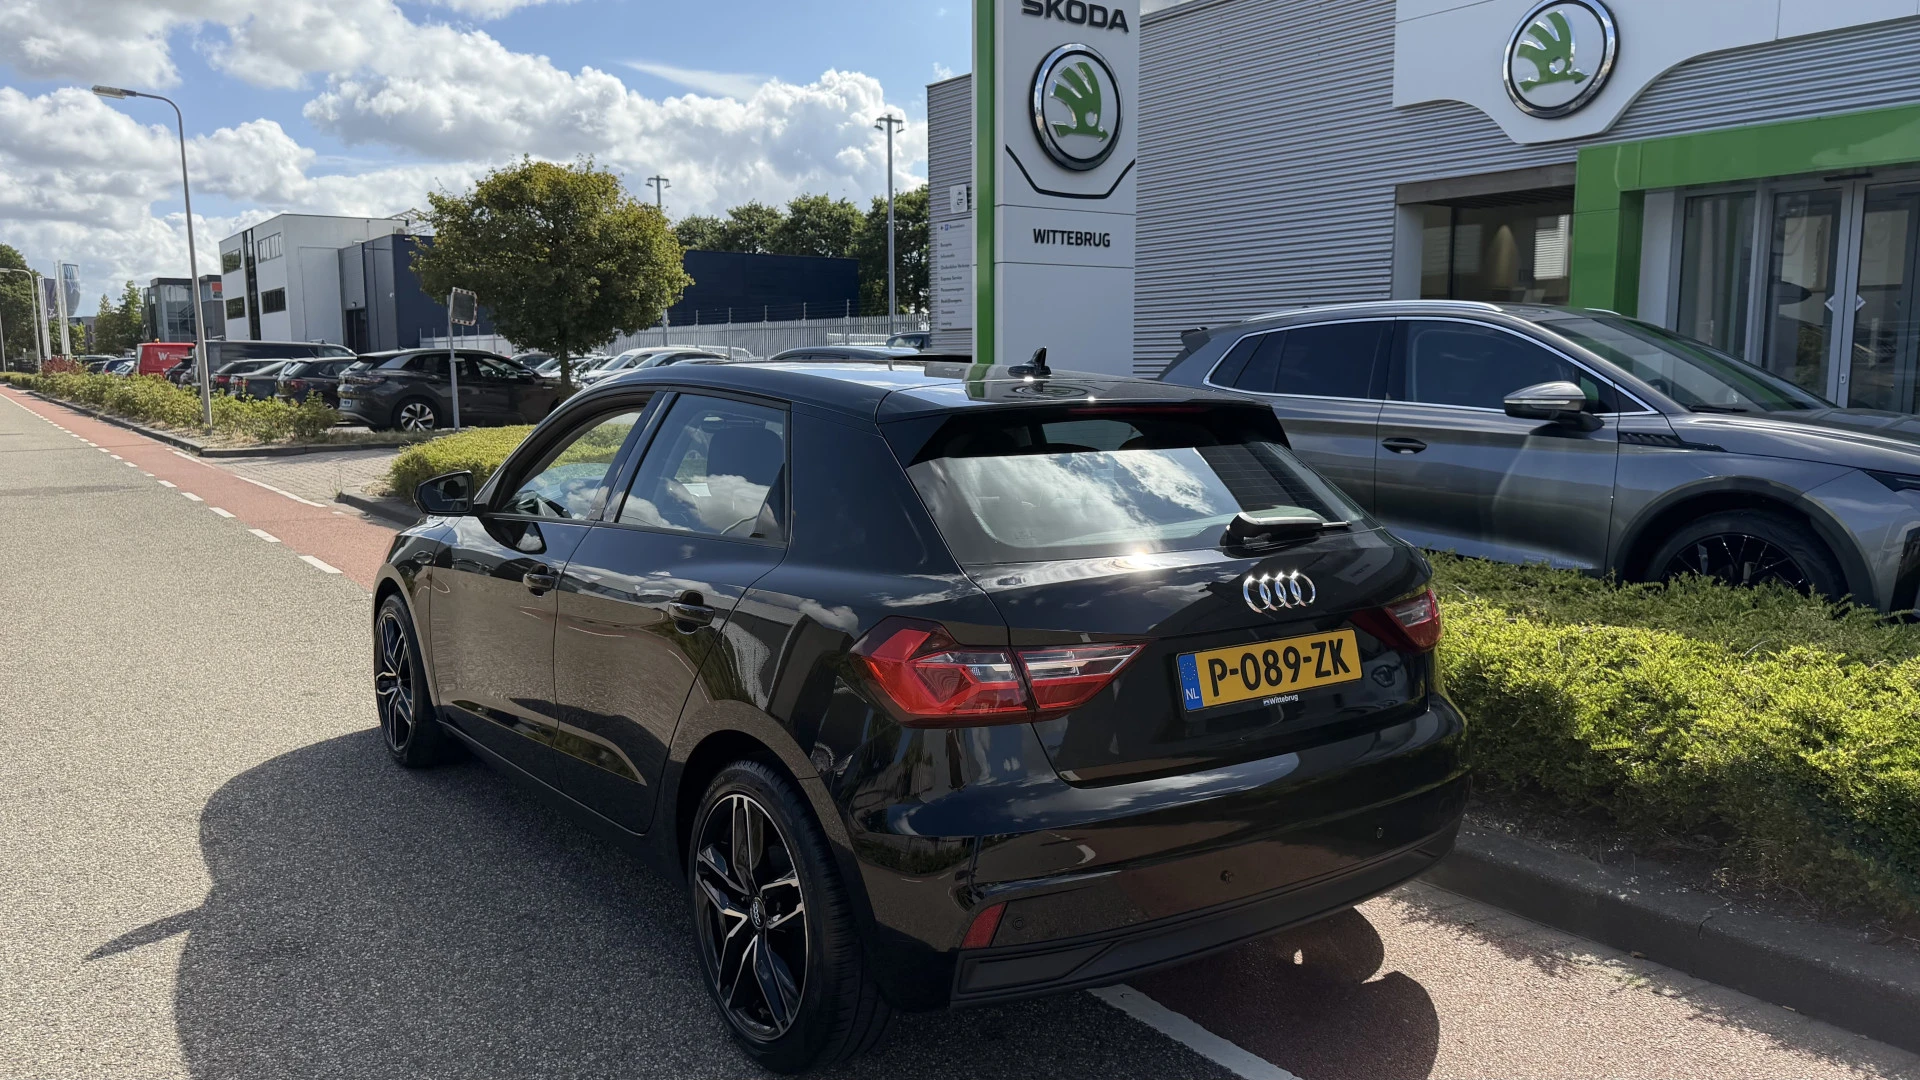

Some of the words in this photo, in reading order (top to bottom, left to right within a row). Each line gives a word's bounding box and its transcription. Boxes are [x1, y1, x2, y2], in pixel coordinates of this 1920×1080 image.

[1033, 228, 1111, 248] WITTEBRUG
[1207, 638, 1351, 697] P-089-ZK
[1185, 687, 1200, 701] NL
[1269, 693, 1299, 705] Wittebrug
